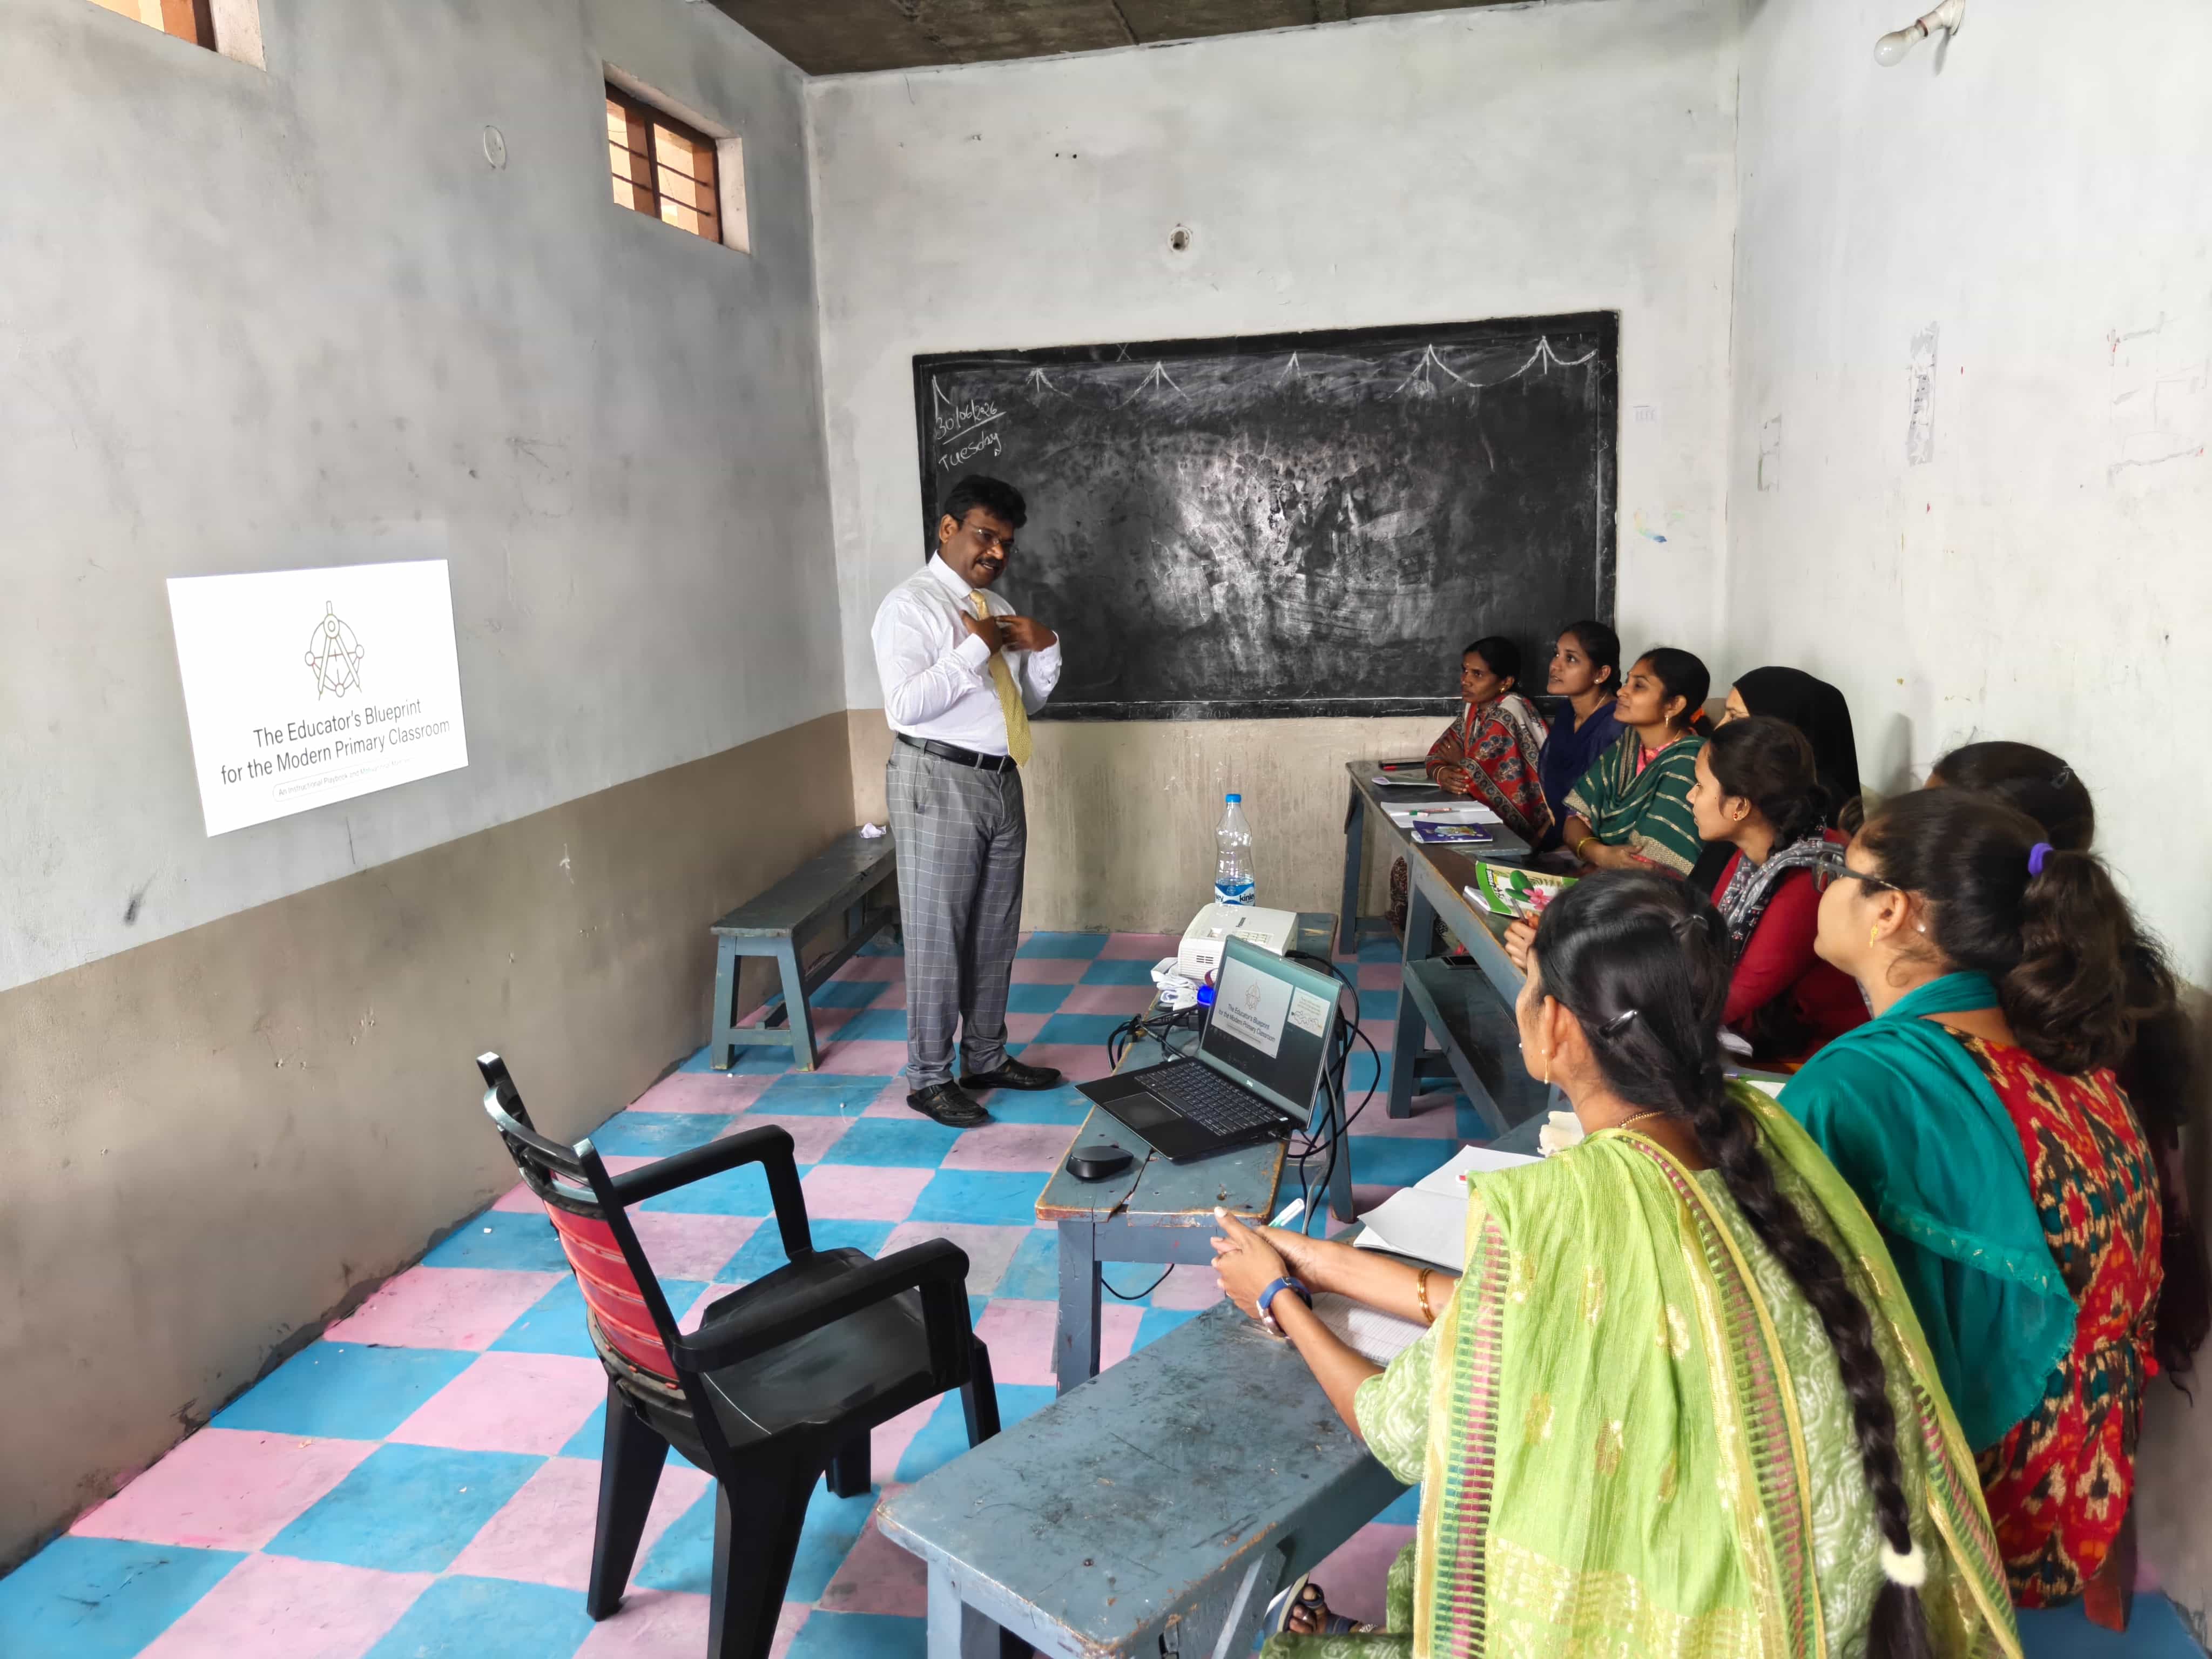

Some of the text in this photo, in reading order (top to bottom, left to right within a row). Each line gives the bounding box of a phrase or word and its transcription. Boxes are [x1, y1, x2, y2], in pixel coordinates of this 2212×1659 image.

[939, 431, 1002, 472] Tuesday
[253, 698, 421, 748] The Educator's Blueprint
[221, 720, 450, 785] for the Modern Primary Classroom
[279, 788, 287, 796] An
